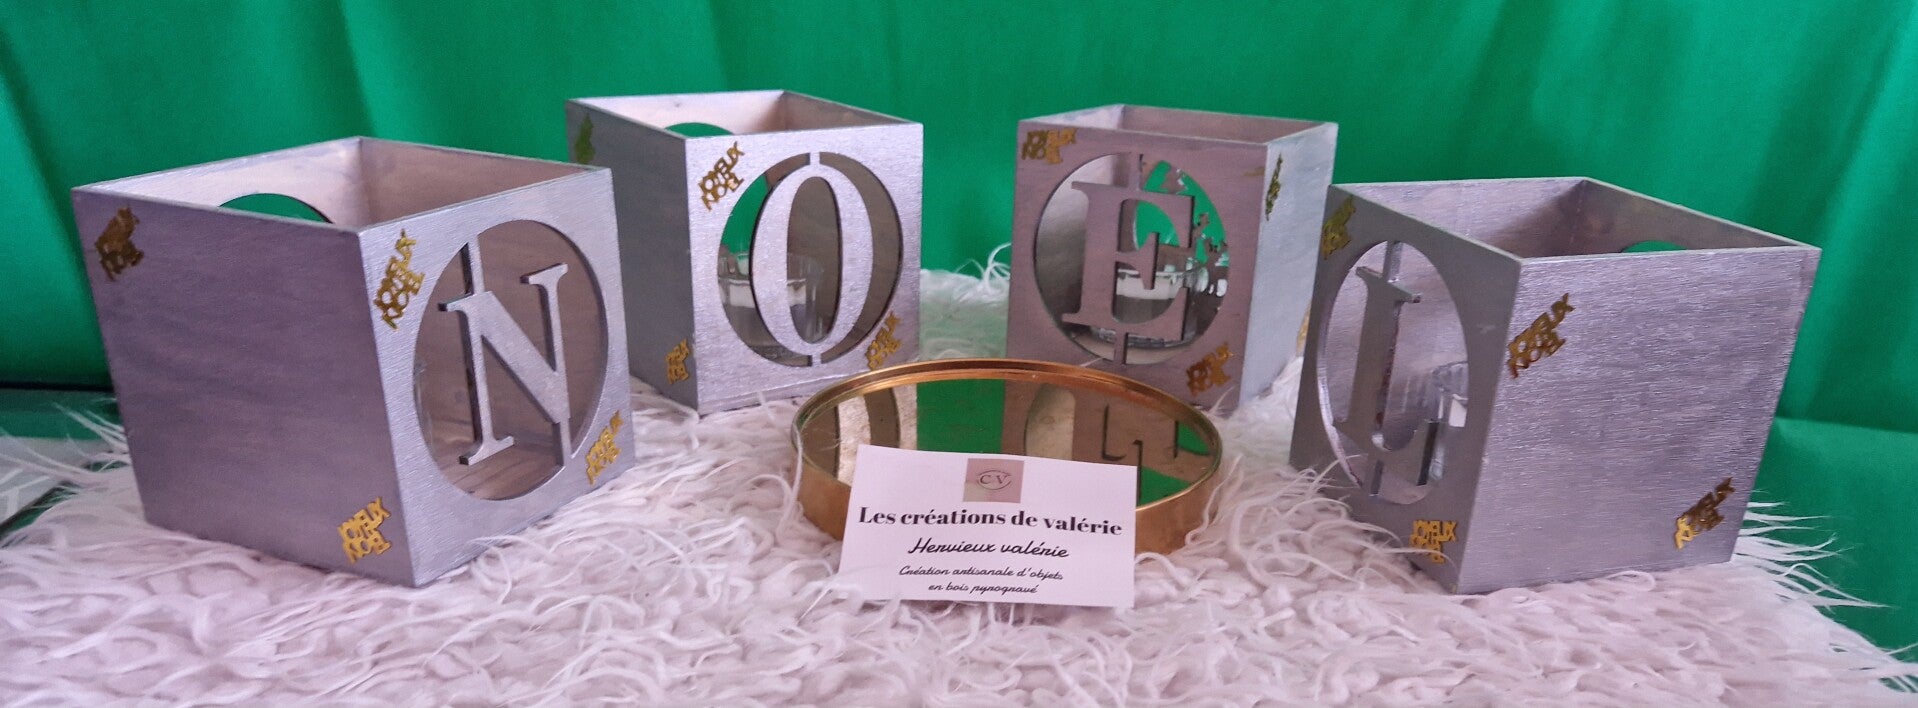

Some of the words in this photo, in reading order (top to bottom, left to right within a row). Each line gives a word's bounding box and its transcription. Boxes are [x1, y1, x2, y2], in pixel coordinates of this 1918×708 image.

[752, 167, 875, 356] O
[1061, 181, 1195, 341] E
[438, 263, 571, 468] N
[858, 506, 896, 525] Les
[900, 508, 1006, 526] créations
[1011, 510, 1038, 527] de
[1043, 516, 1122, 535] valérie
[907, 537, 996, 554] Hervieux
[1000, 540, 1069, 558] valérie
[899, 565, 949, 576] Création
[952, 566, 1014, 577] artisanale
[1016, 568, 1063, 580] d'objets
[946, 582, 969, 591] bois
[970, 584, 1037, 596] pyrogravé
